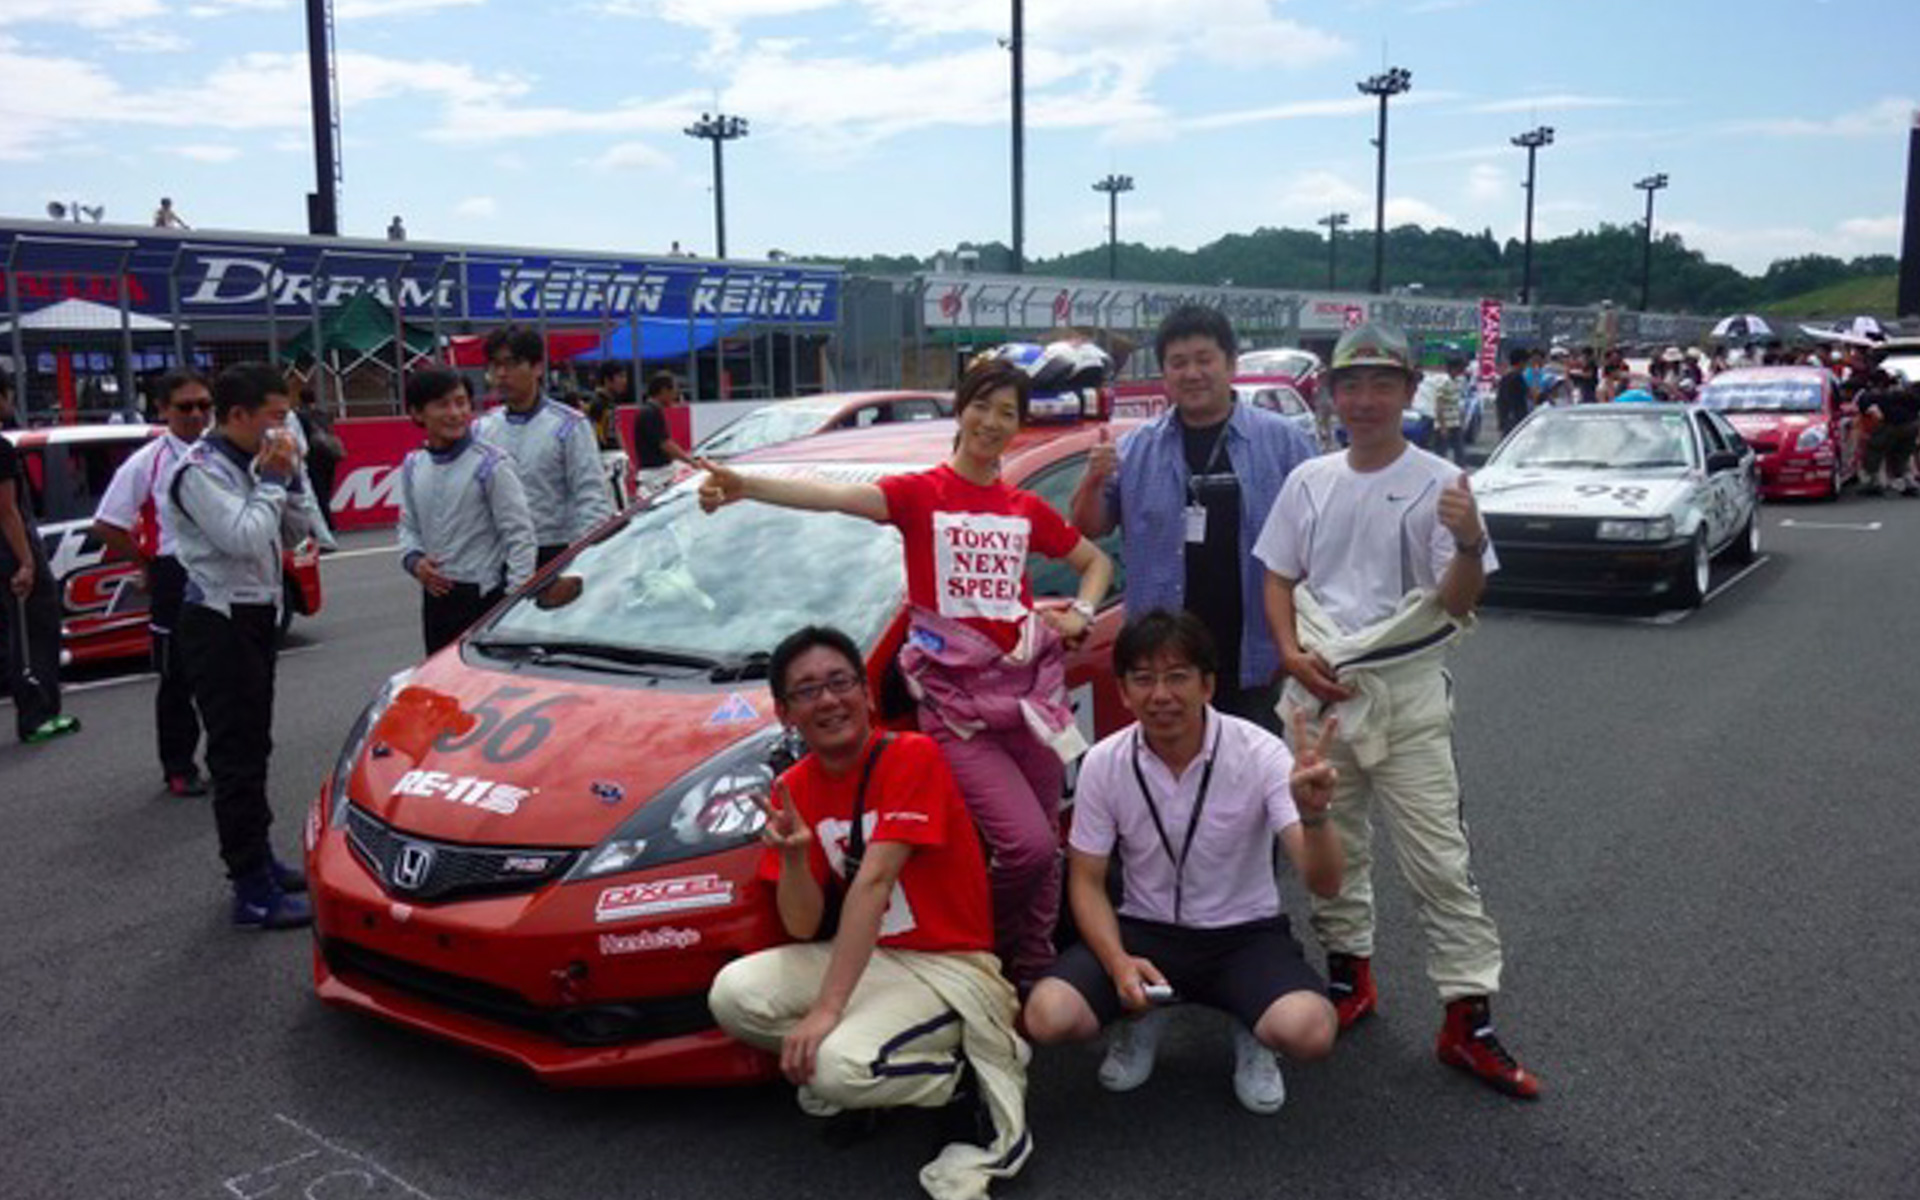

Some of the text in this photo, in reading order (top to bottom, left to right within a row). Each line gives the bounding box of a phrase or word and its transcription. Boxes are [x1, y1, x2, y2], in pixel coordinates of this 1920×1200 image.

[181, 256, 457, 309] DREAM
[495, 268, 668, 312] KEIHIN
[692, 275, 827, 317] KEIHIN
[953, 551, 1020, 575] NEXT
[431, 686, 585, 763] 56
